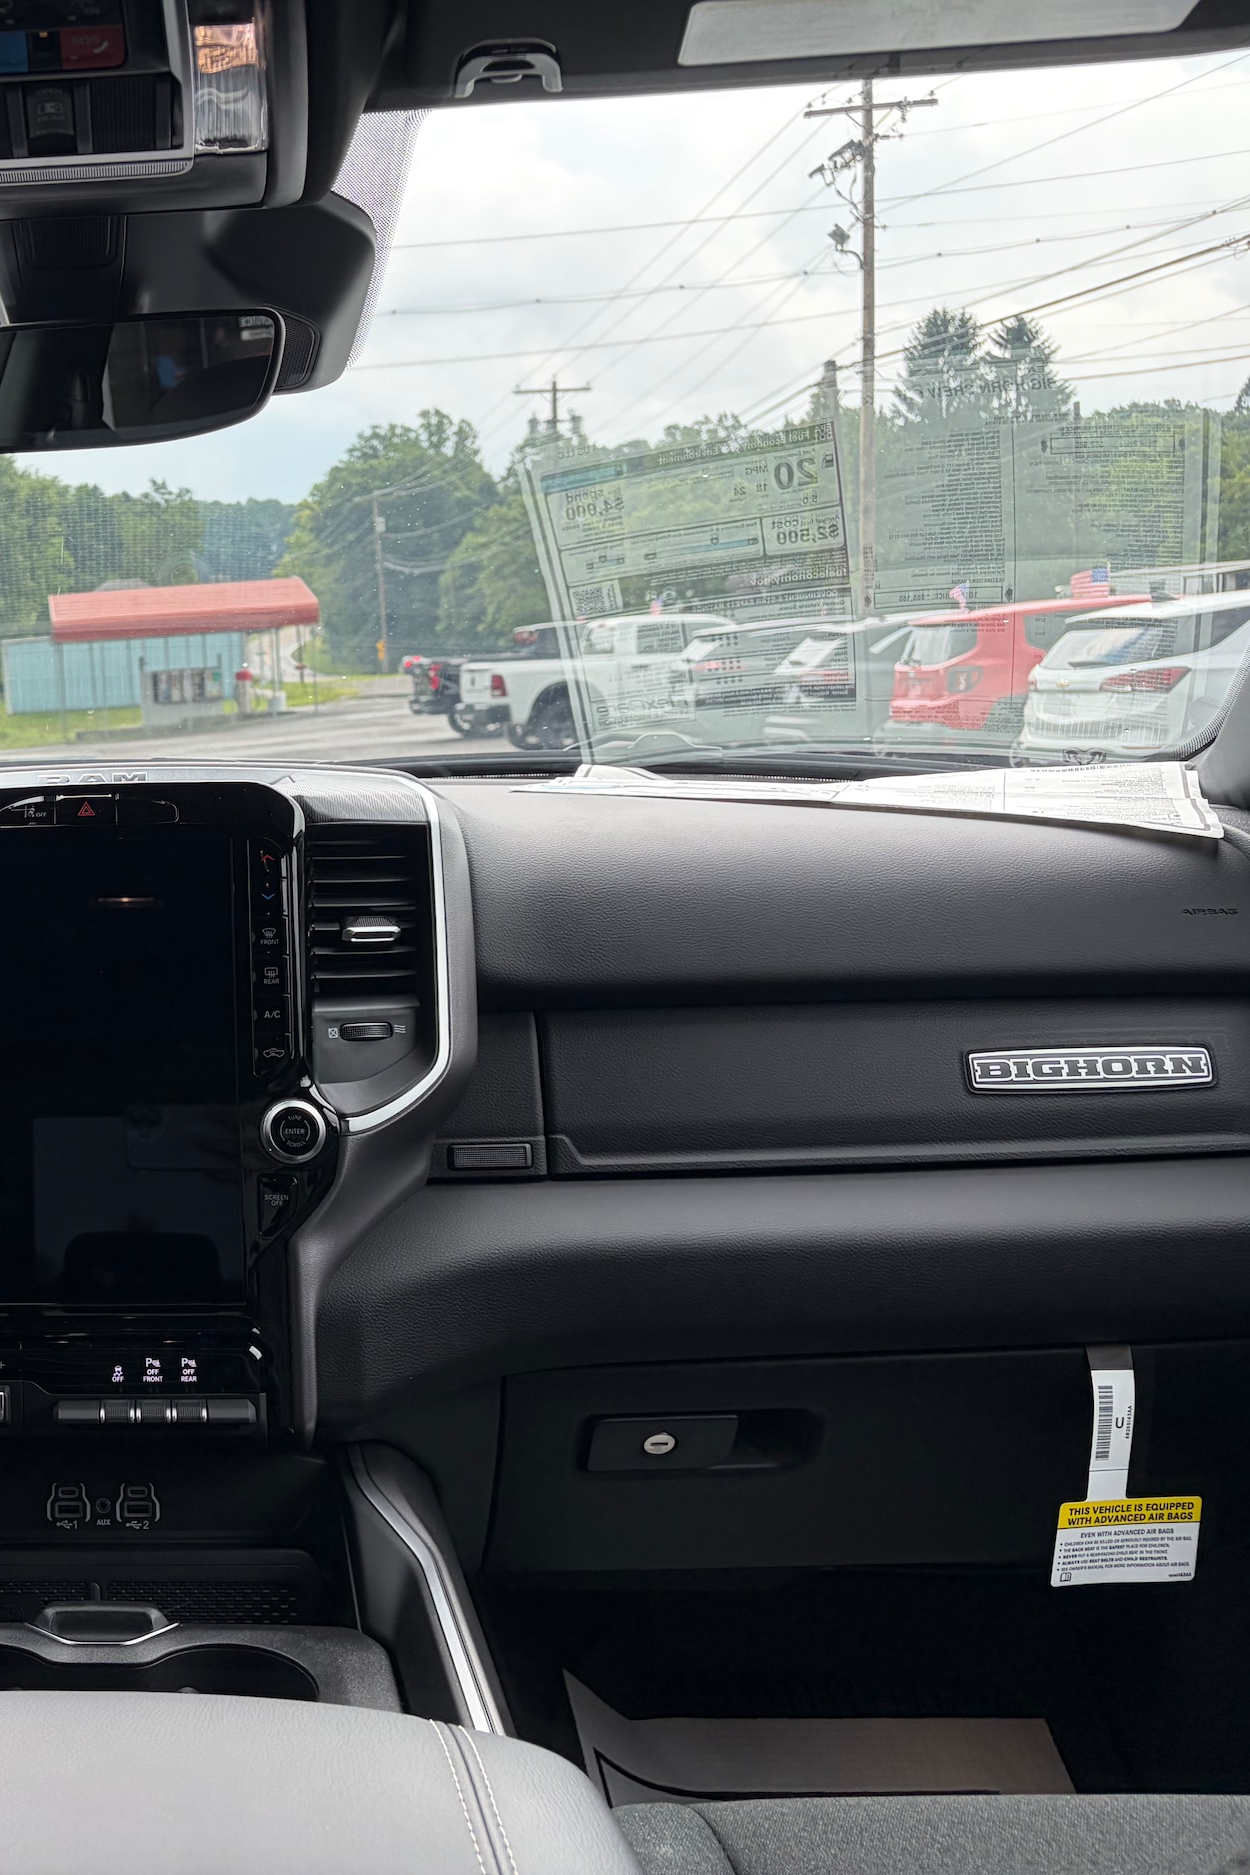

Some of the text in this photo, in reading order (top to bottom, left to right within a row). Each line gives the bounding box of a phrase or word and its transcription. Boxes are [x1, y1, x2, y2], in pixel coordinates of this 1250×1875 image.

[70, 34, 100, 46] SOS
[260, 938, 280, 946] FRONT
[263, 977, 280, 985] REAR
[263, 1010, 281, 1020] A/C
[974, 1054, 1208, 1083] BIGHORN
[146, 1368, 159, 1376] OFF
[182, 1368, 195, 1376] OFF
[142, 1375, 164, 1383] FRONT
[180, 1375, 198, 1383] REAR
[1069, 1502, 1195, 1516] THIS VEHICLE IS EQUIPPED
[96, 1518, 111, 1526] AUX
[1067, 1511, 1193, 1526] WITH ADVANCED AIR BAGS
